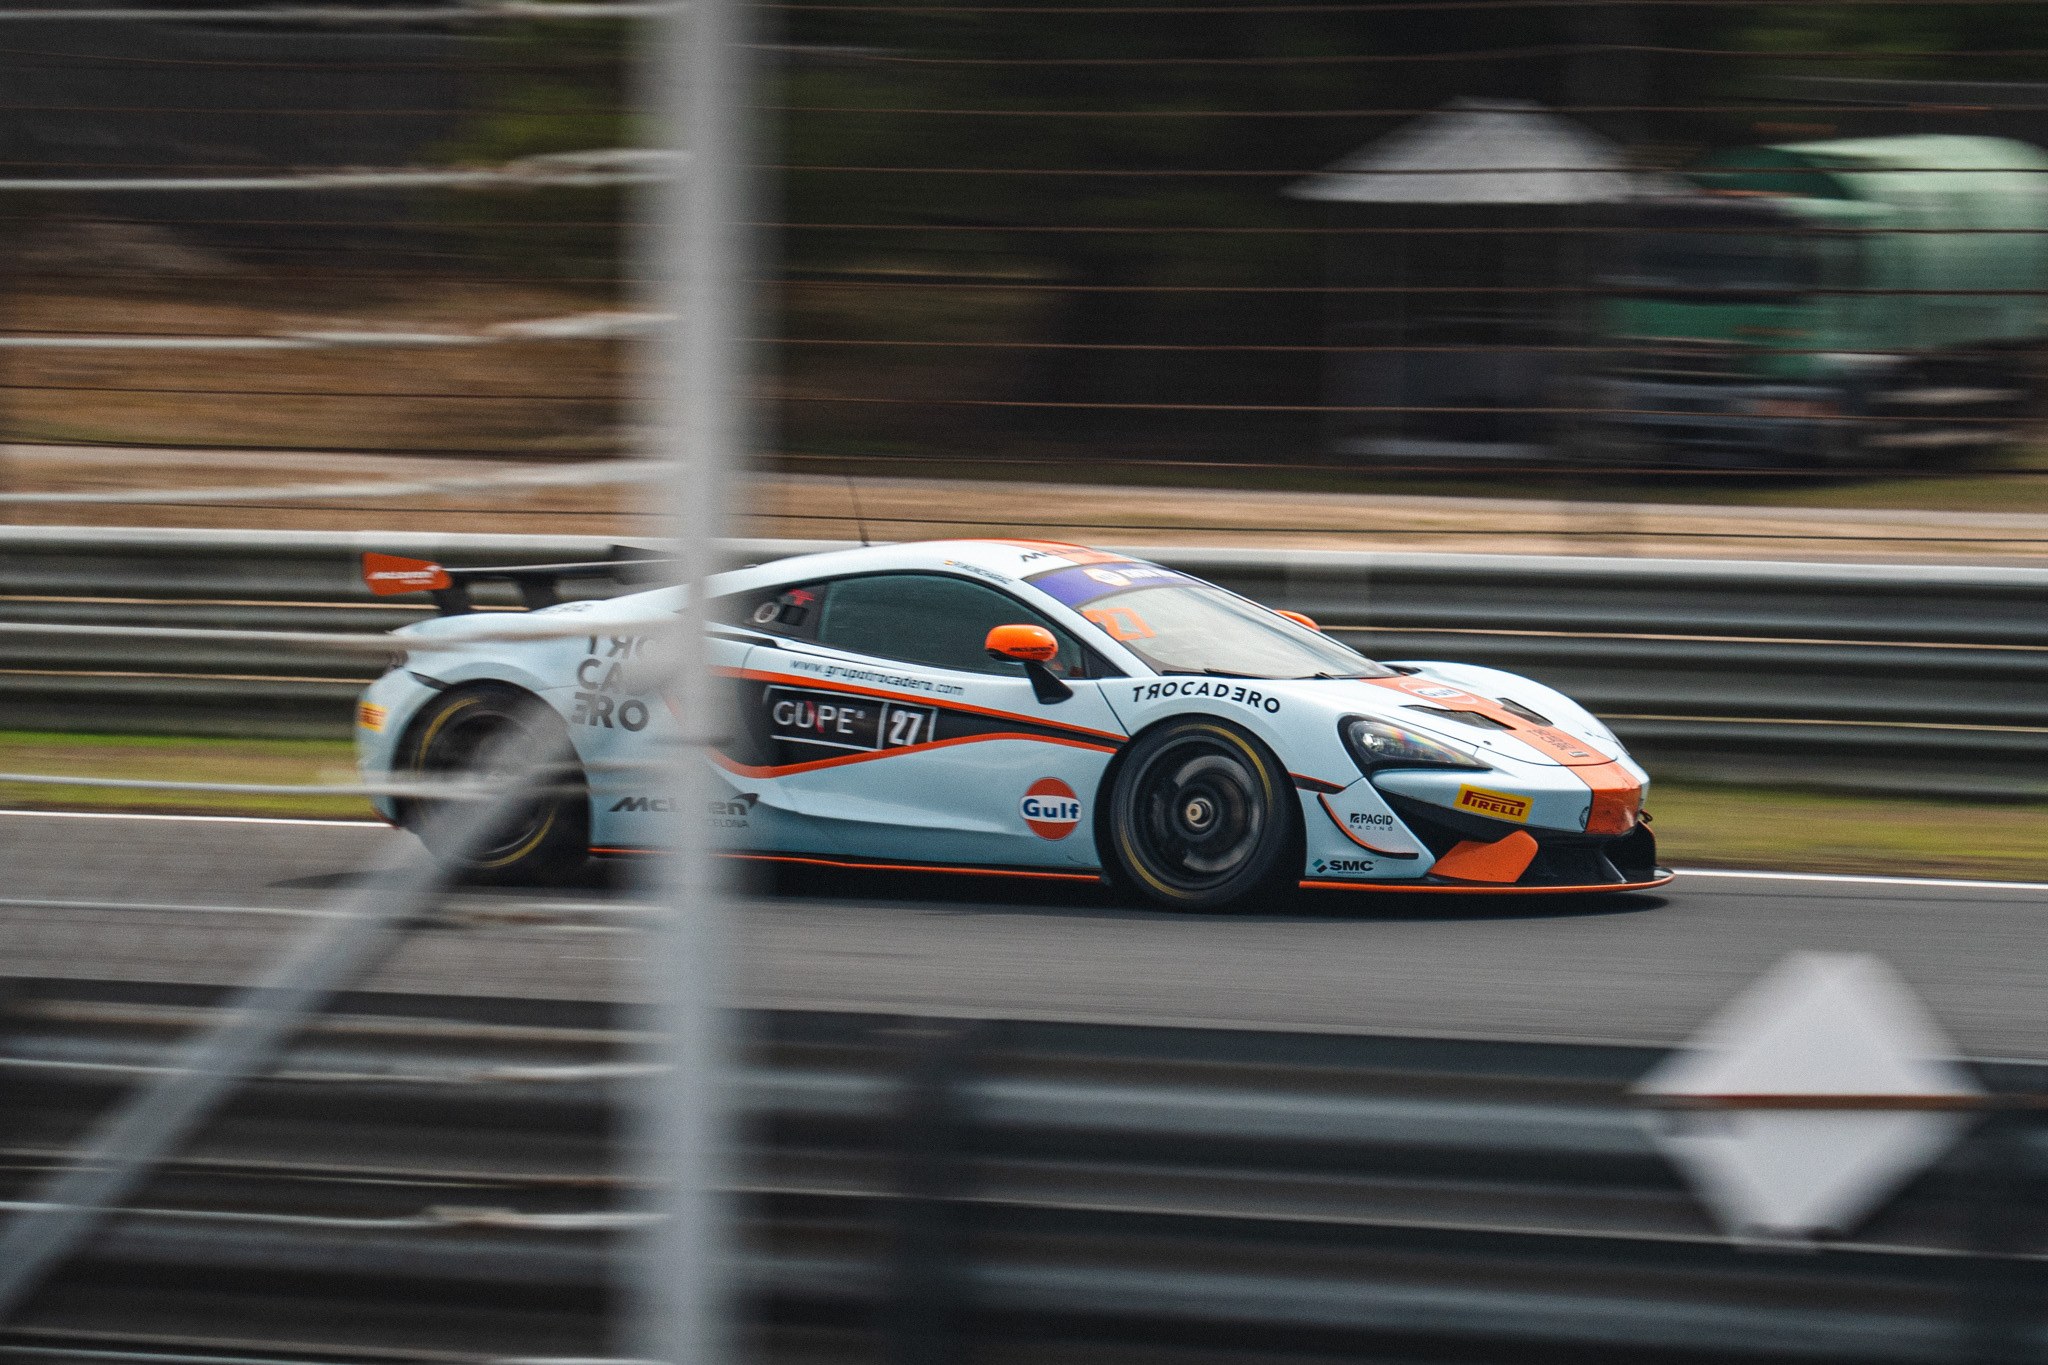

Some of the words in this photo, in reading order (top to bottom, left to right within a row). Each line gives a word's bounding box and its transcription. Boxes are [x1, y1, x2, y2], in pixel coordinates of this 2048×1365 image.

[1132, 681, 1281, 714] TROCADERO
[888, 710, 924, 746] 27
[1023, 798, 1079, 819] Gulf
[1462, 790, 1526, 817] PIRELLI
[1350, 824, 1393, 832] RACING
[1361, 813, 1394, 825] PAGID
[1330, 860, 1374, 871] SMC
